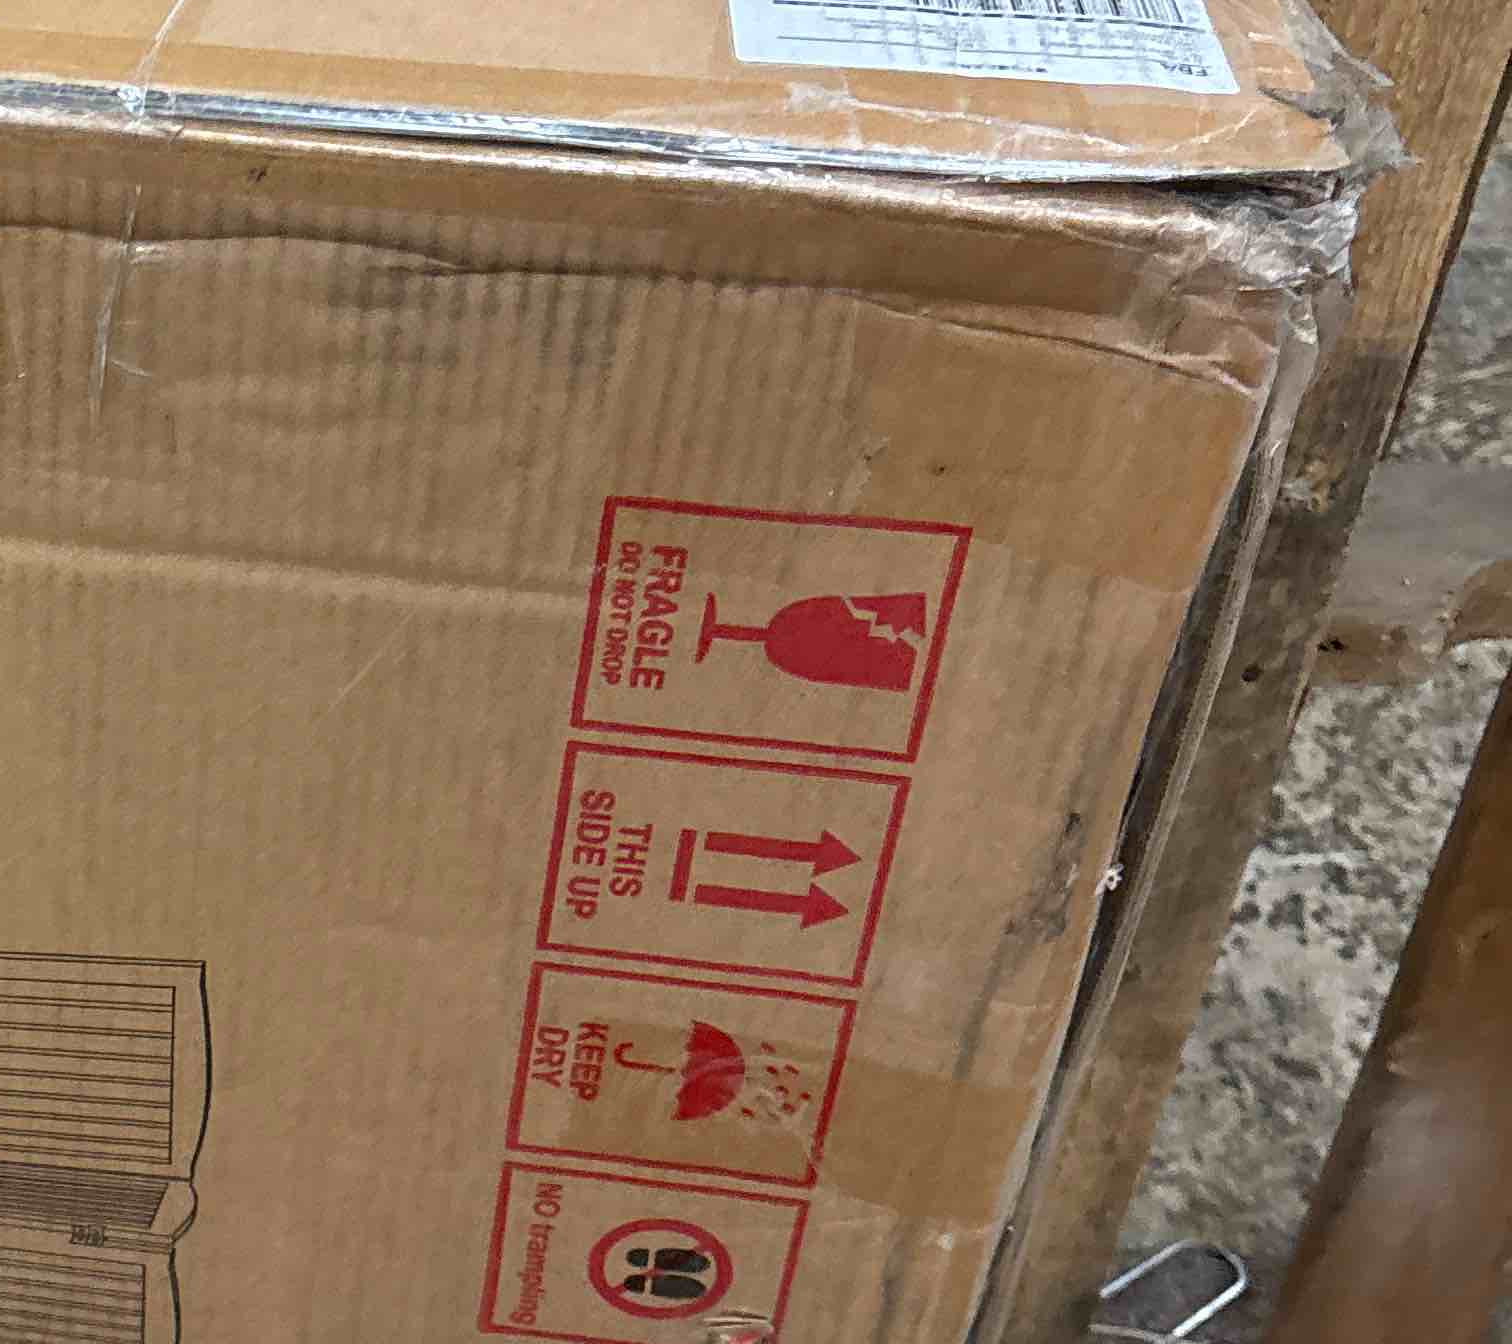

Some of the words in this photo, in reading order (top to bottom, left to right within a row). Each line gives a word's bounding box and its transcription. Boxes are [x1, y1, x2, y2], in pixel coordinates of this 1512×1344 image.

[618, 541, 643, 573] DO
[610, 579, 637, 624] NOT
[628, 544, 690, 690] FRAGLE
[600, 628, 629, 686] DROP
[572, 788, 616, 867] SIDE
[608, 822, 654, 897] THIS
[567, 877, 601, 920] UP
[531, 1027, 570, 1087] DRY
[571, 1022, 610, 1103] KEEP
[533, 1182, 564, 1217] NO
[509, 1224, 554, 1326] trampling
